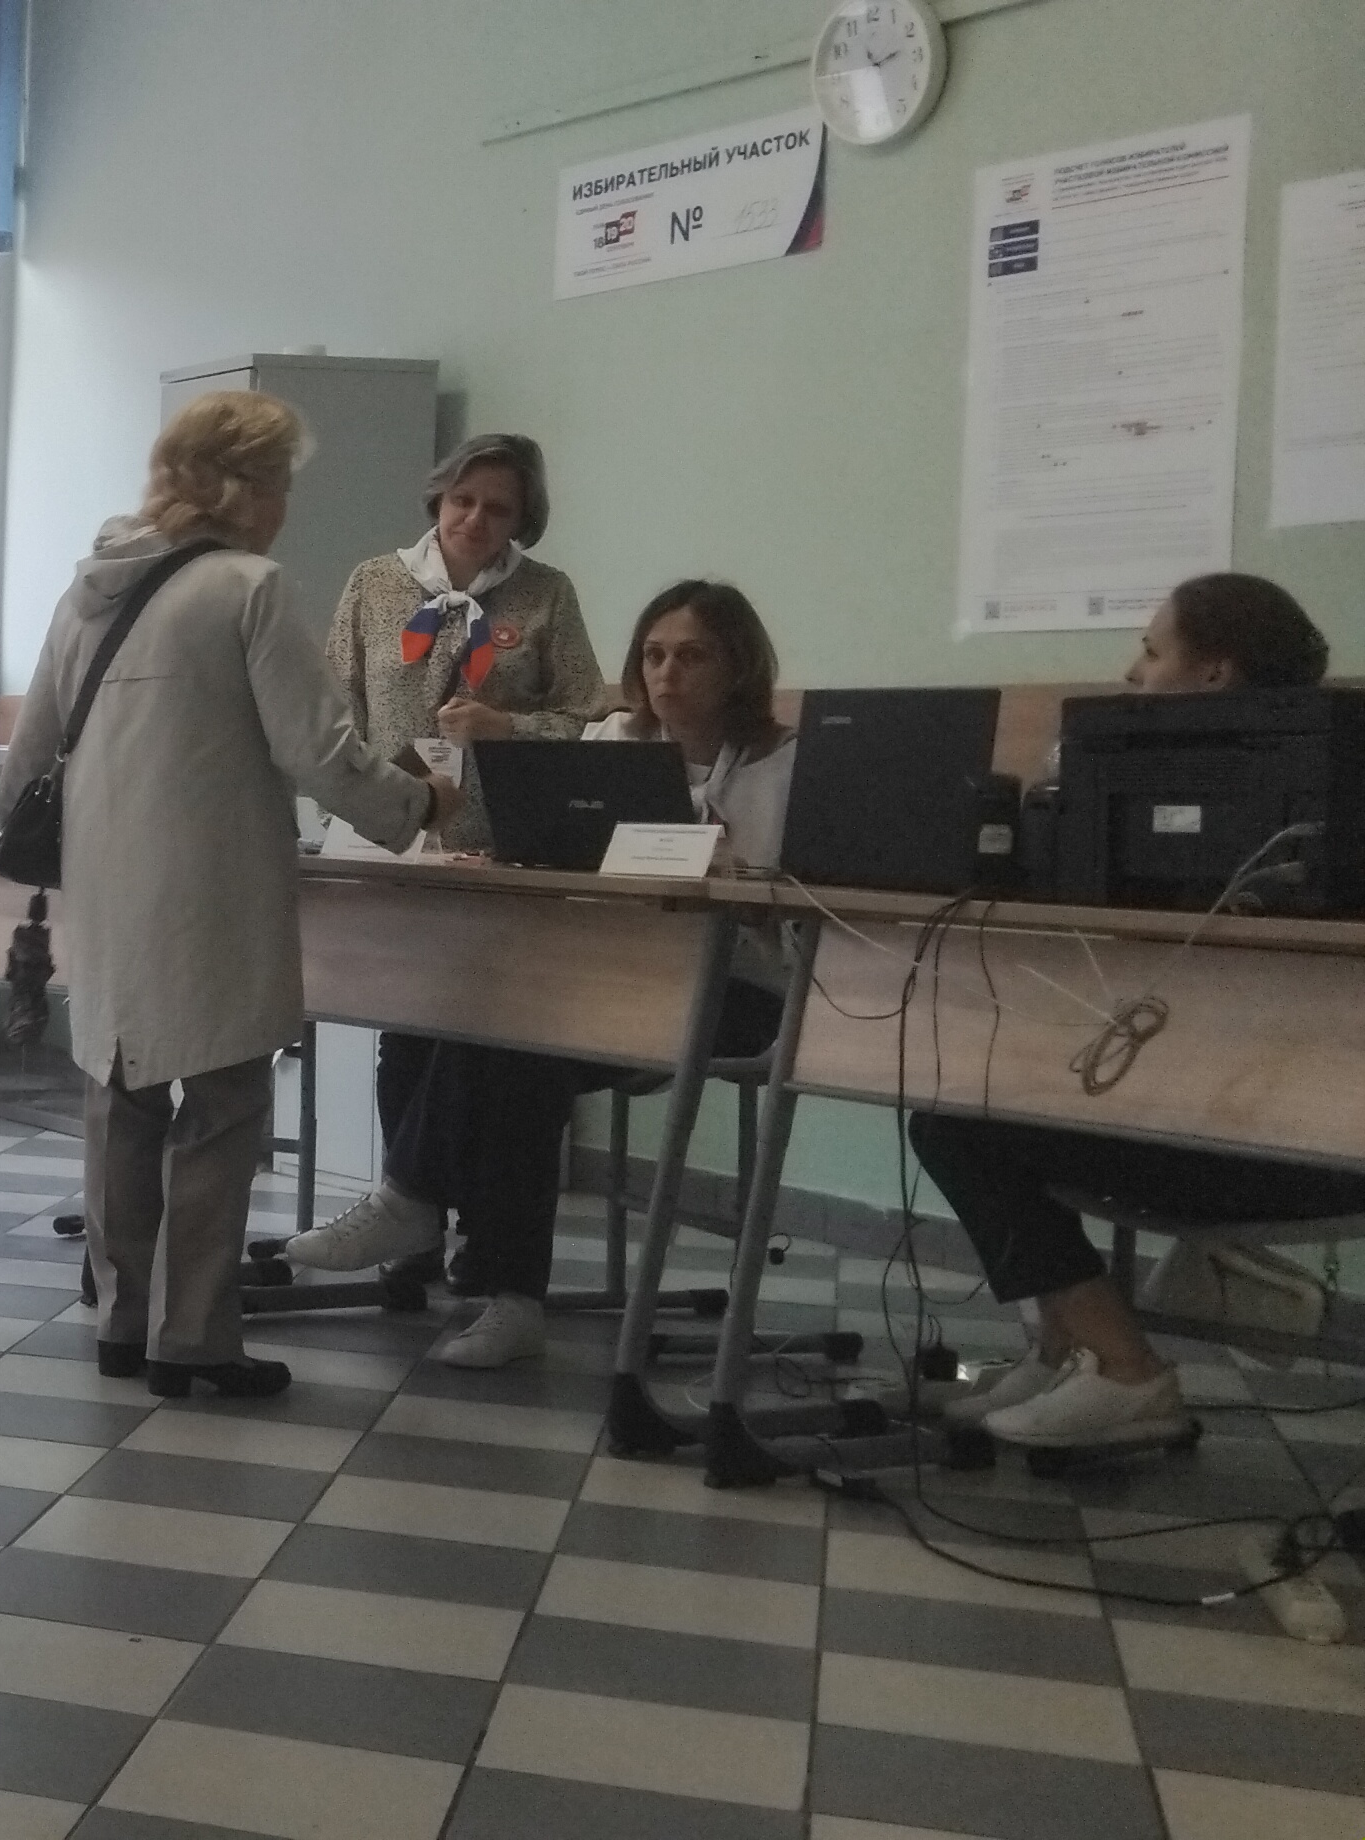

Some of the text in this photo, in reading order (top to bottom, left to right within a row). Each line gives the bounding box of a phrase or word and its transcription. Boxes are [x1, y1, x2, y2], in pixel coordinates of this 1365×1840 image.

[571, 128, 811, 201] ИЗБИРАТЕЛЬНЫЙ УЧАСТОК
[670, 205, 704, 245] №
